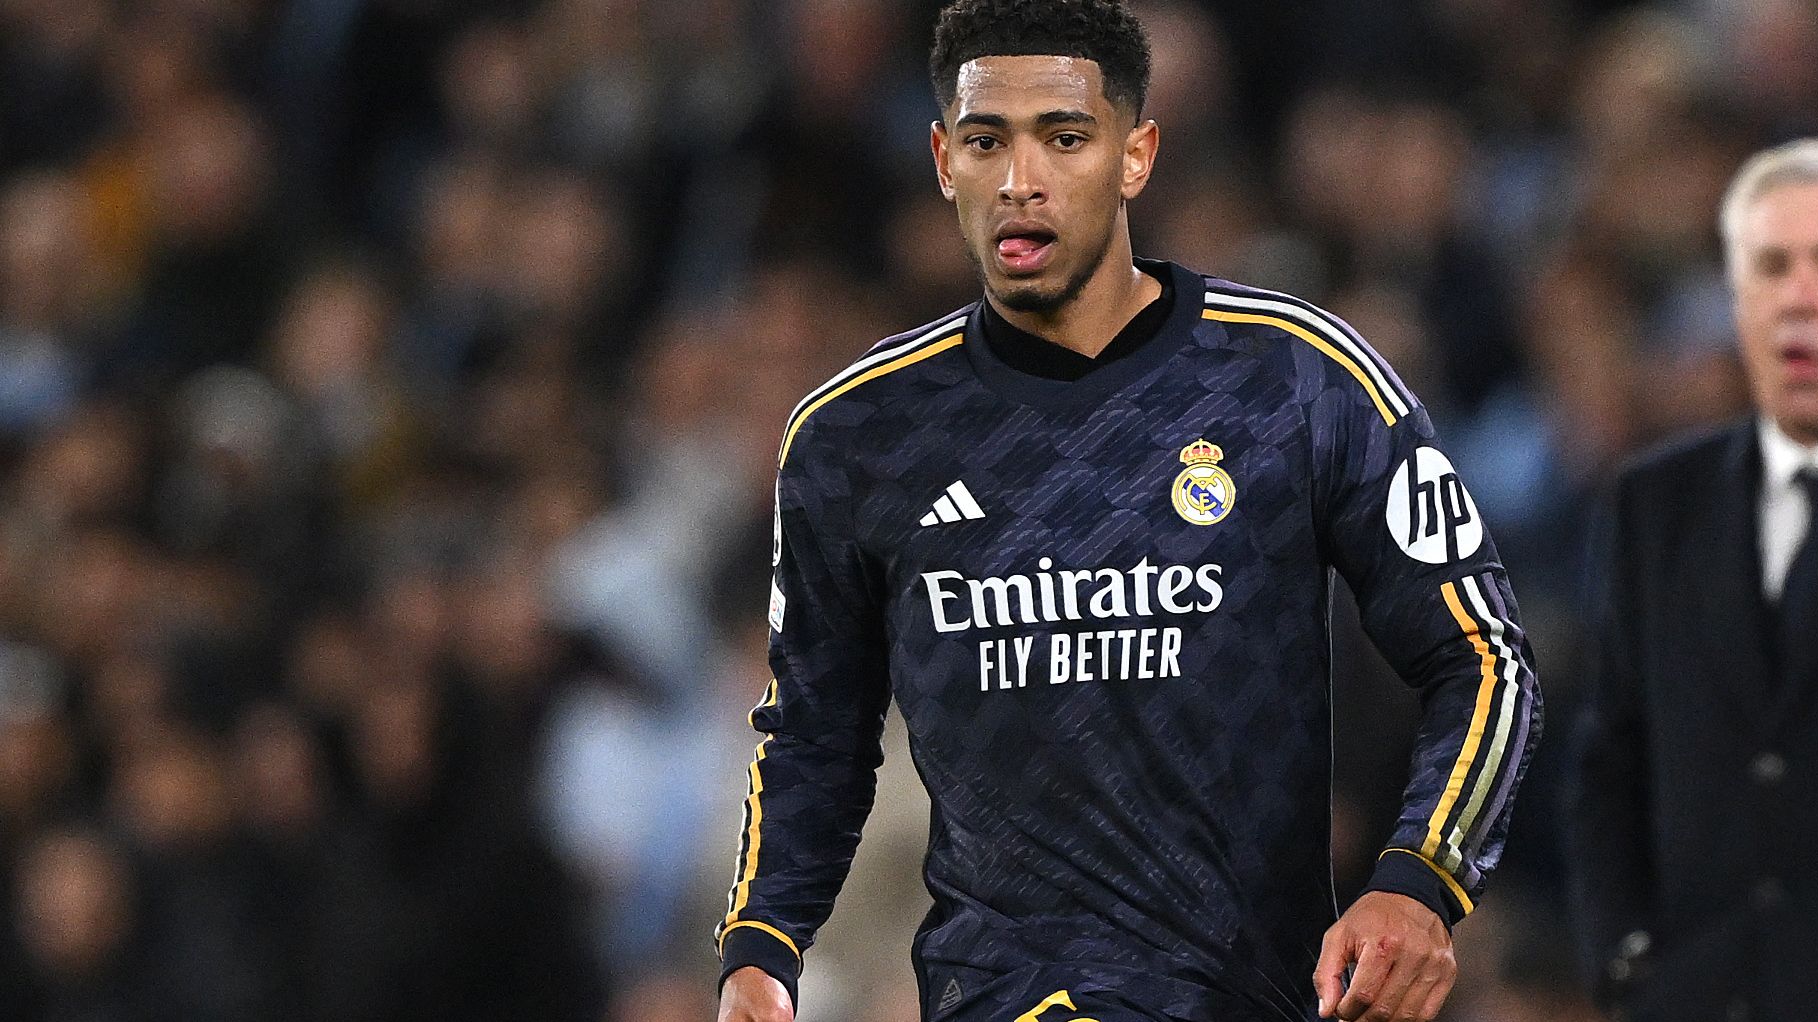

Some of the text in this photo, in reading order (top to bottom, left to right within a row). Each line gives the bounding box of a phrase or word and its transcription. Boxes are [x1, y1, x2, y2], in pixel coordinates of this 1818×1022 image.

[1406, 449, 1471, 563] hp
[920, 556, 1224, 633] Emirates
[979, 627, 1182, 691] FLY BETTER
